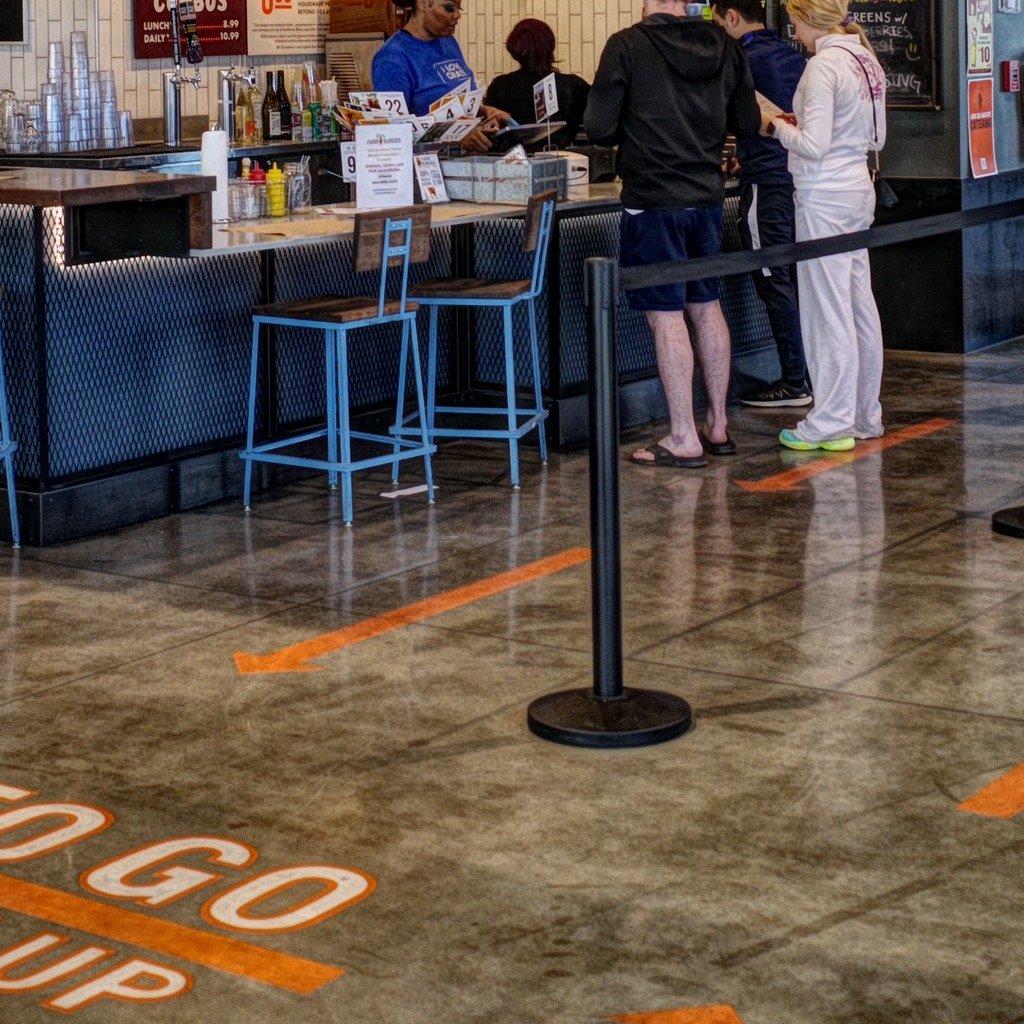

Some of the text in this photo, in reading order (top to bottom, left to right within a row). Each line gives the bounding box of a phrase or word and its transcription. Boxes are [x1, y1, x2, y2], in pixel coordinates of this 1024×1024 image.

[222, 19, 239, 29] 8.99
[220, 31, 239, 41] 10.99
[384, 99, 403, 116] 22
[466, 97, 476, 113] 3
[446, 108, 454, 119] 4
[80, 834, 377, 932] GO
